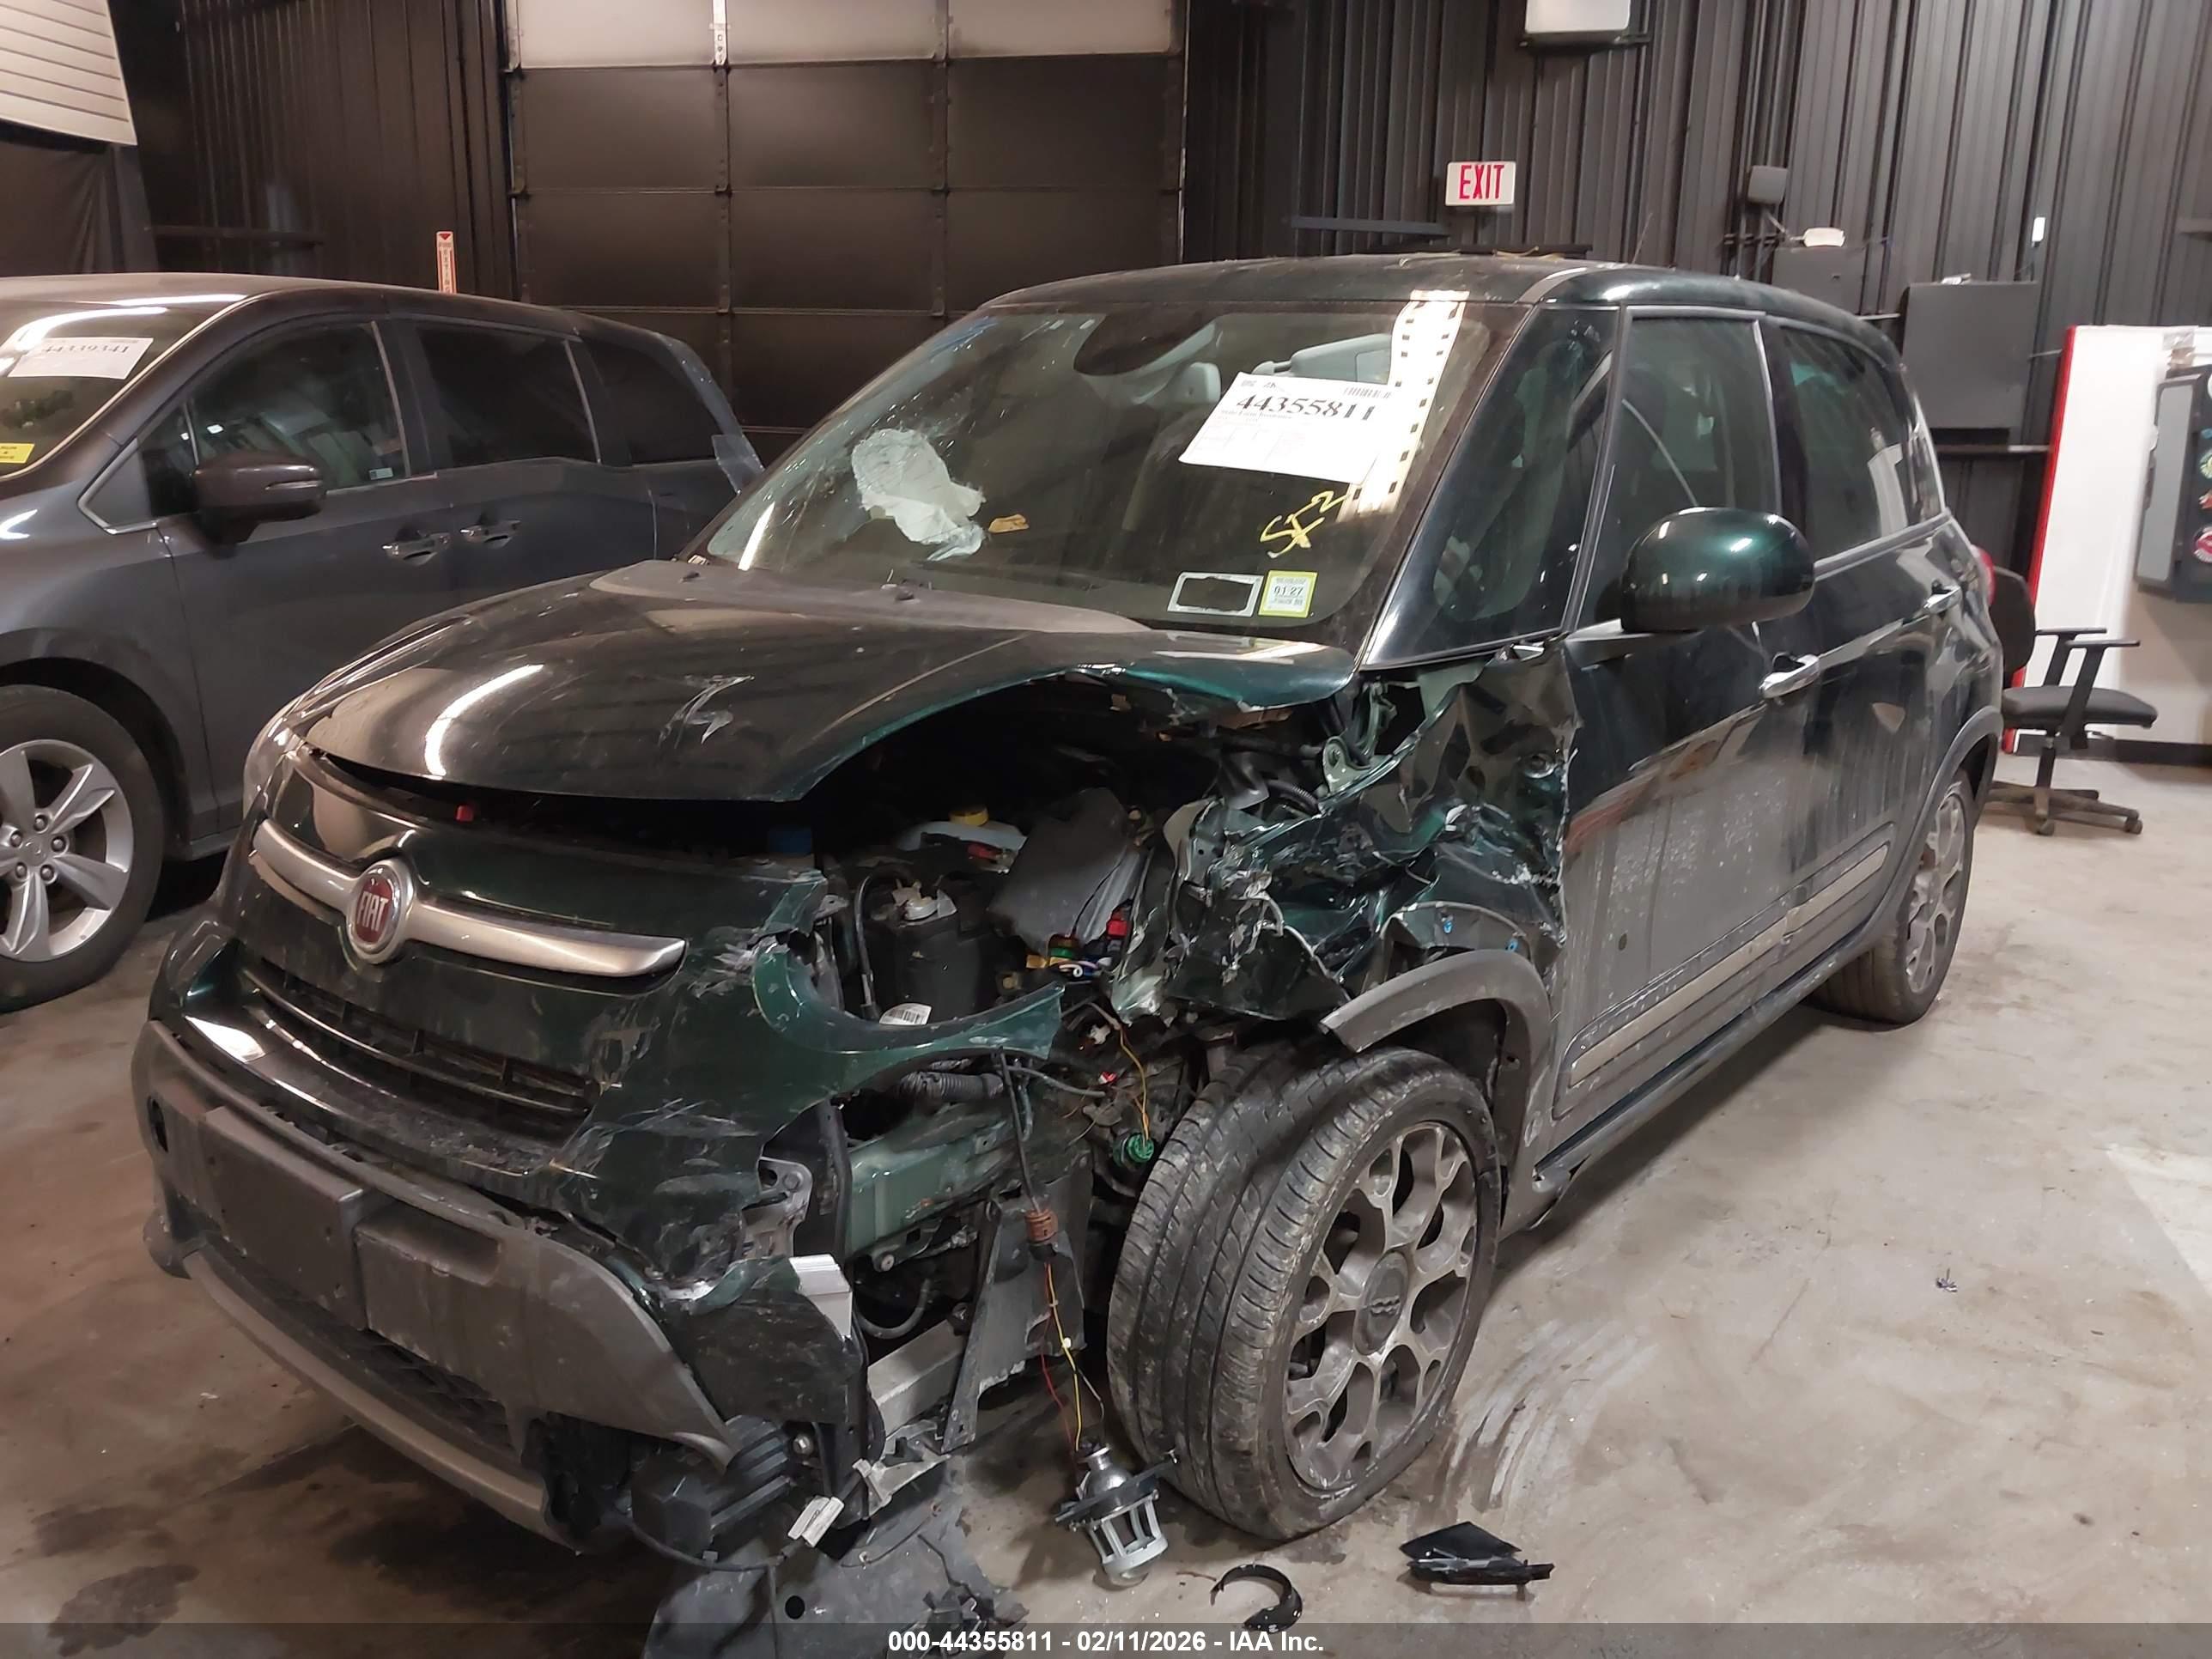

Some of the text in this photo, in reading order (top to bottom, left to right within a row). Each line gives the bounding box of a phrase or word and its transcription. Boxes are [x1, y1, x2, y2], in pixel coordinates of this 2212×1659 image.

[1459, 165, 1504, 199] EXIT
[1237, 394, 1376, 421] 44355811
[356, 891, 389, 932] FIAT
